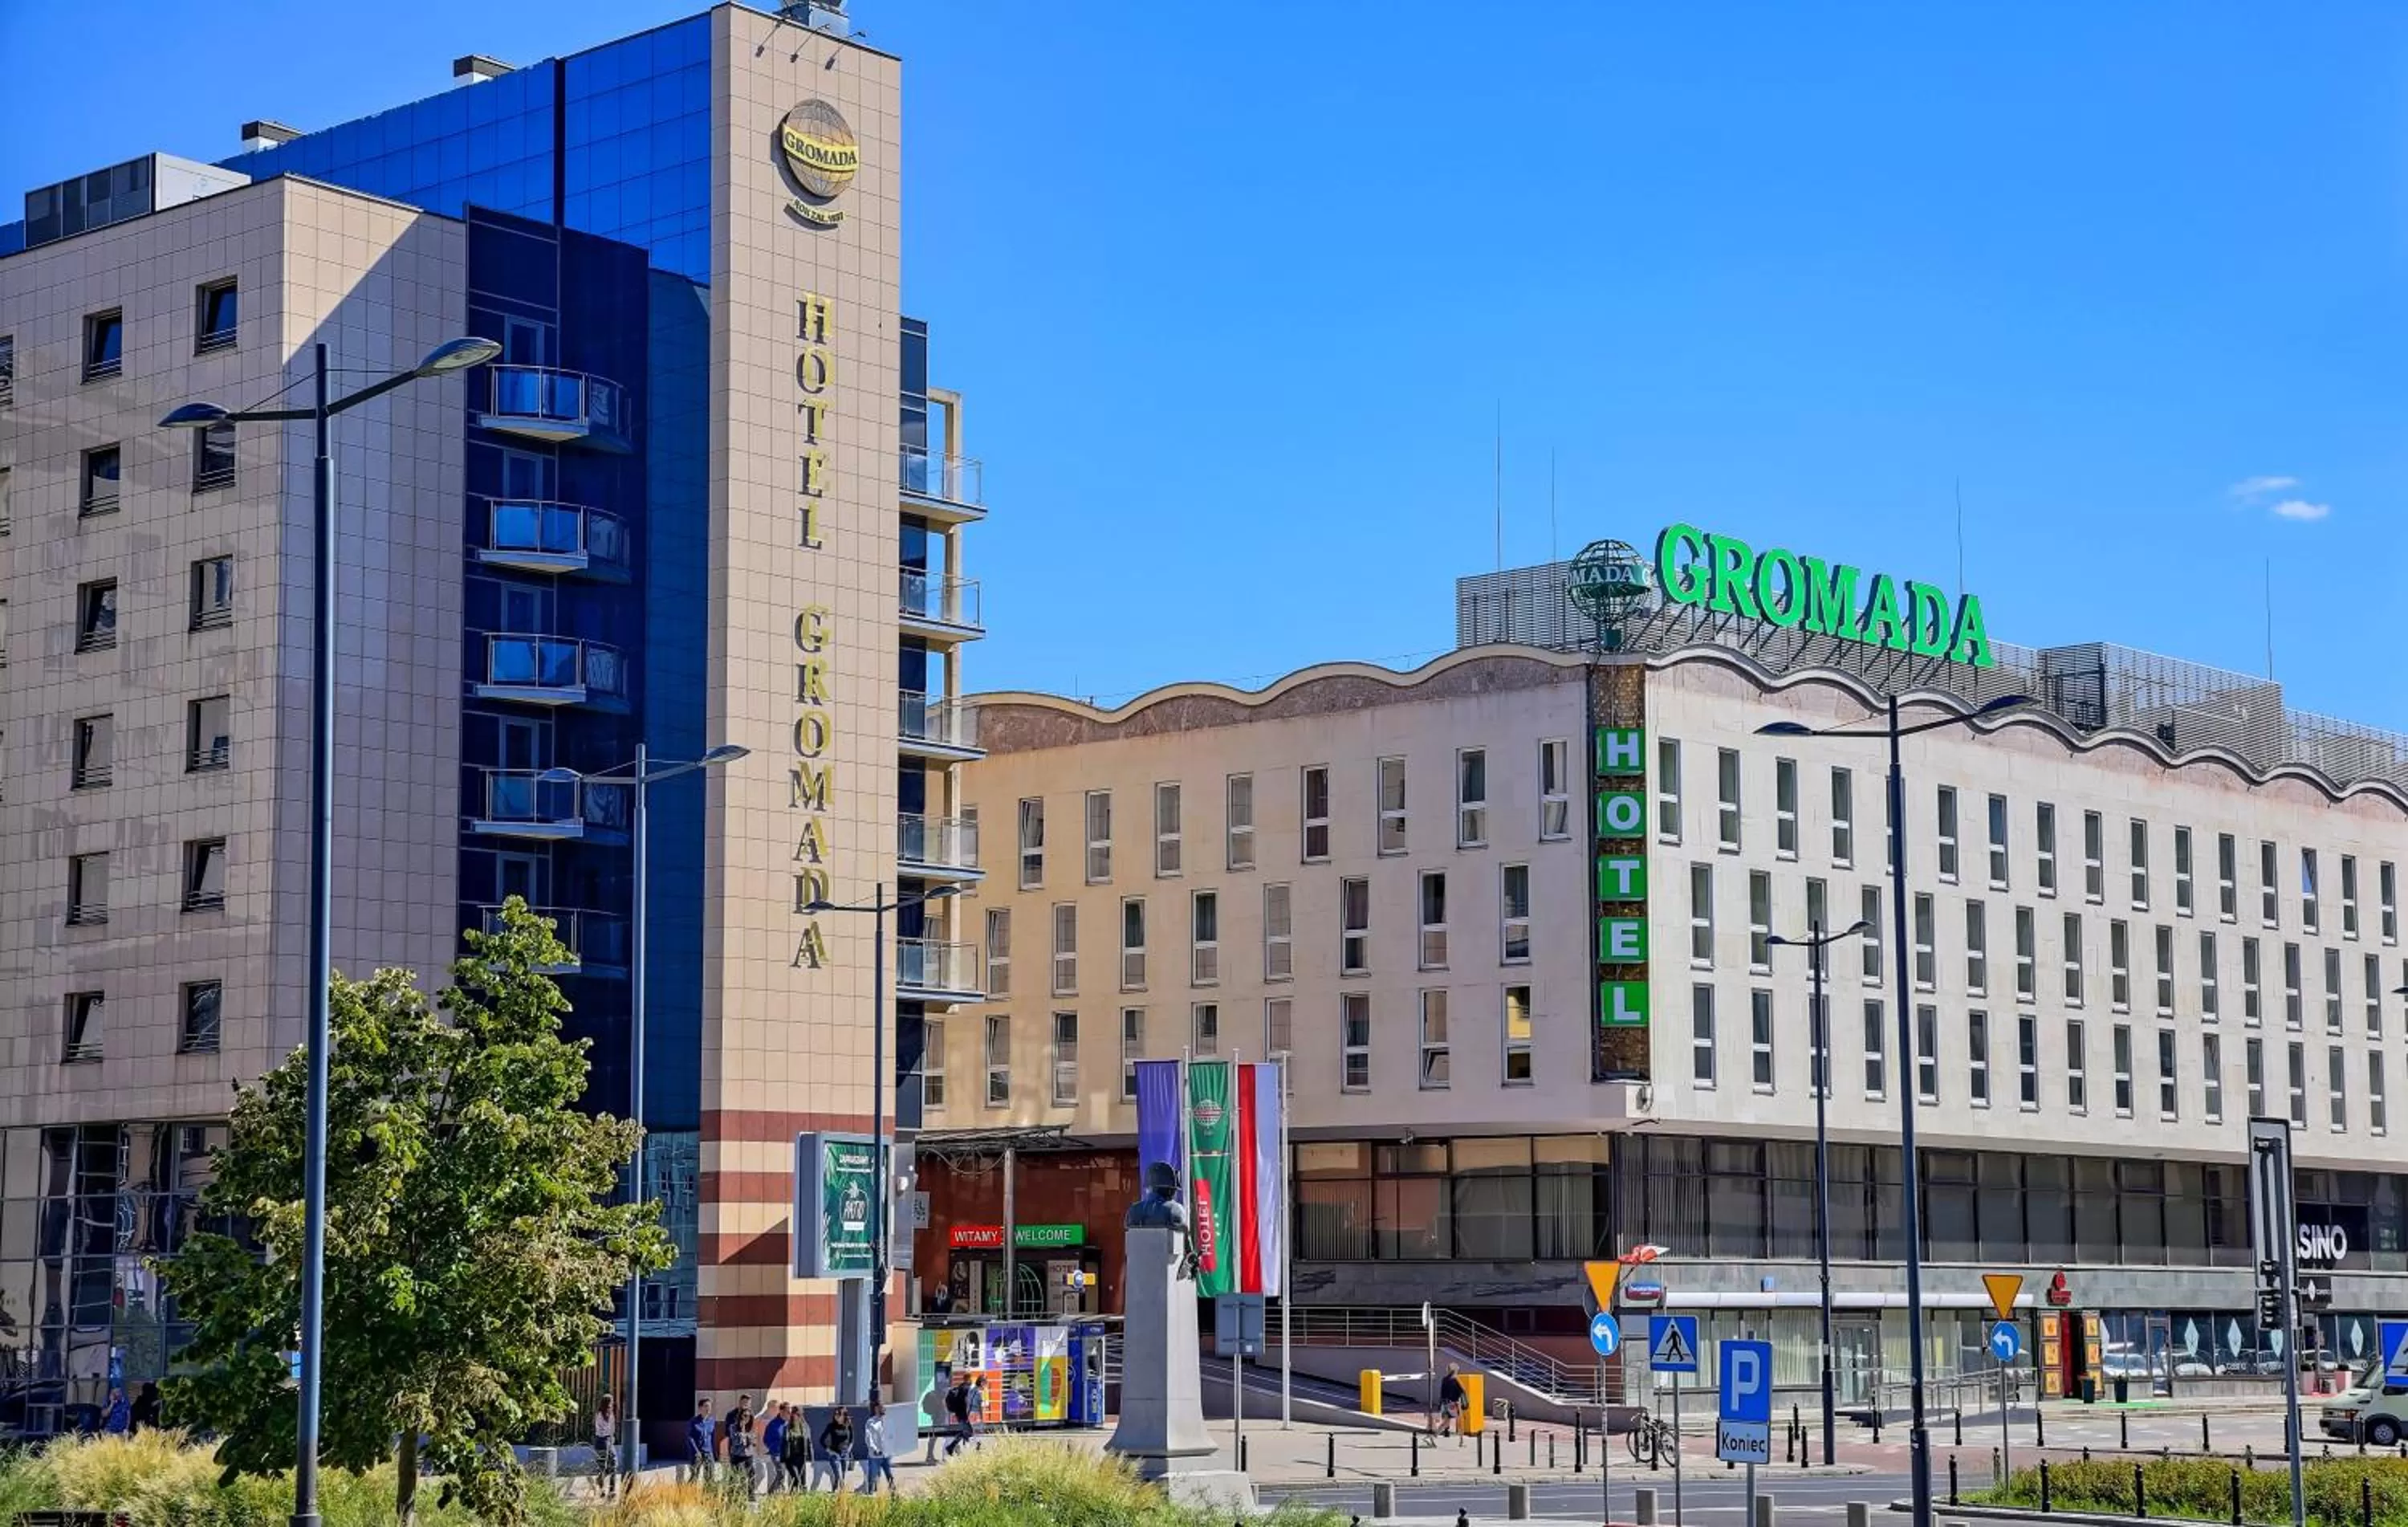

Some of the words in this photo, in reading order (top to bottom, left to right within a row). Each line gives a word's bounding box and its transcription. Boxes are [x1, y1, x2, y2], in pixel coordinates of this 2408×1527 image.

[785, 131, 857, 165] GROMADA
[796, 294, 834, 549] HOTEL
[1656, 523, 1996, 669] GROMADA
[789, 605, 835, 969] GROMADA
[1606, 731, 1641, 1021] HOTEL
[954, 1231, 998, 1242] WITAMY
[1015, 1229, 1071, 1242] WELCOME
[1198, 1199, 1212, 1255] HOTEL
[2296, 1223, 2348, 1260] SINO
[1731, 1350, 1760, 1412] P
[1722, 1431, 1765, 1453] Koniec
